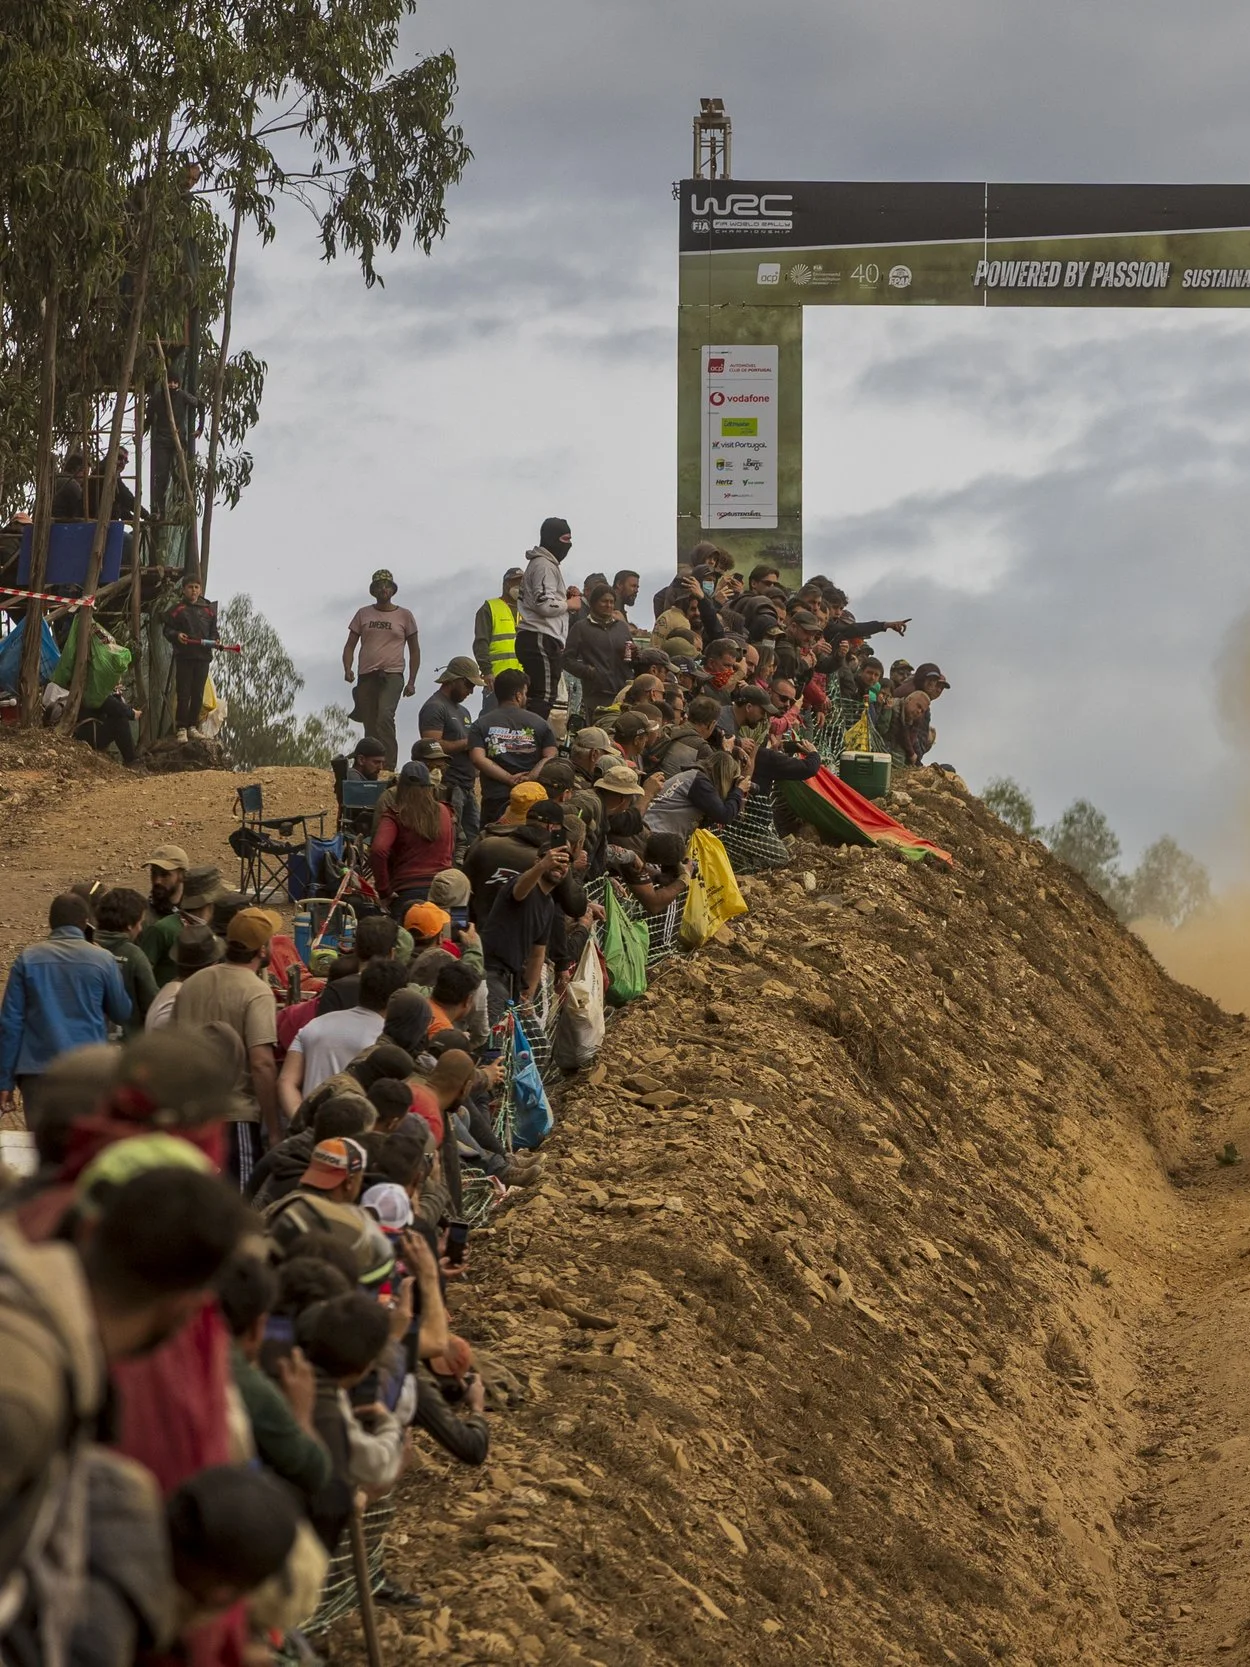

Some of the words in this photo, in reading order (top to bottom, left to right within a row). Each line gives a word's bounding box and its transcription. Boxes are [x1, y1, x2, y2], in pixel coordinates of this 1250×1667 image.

[691, 194, 793, 216] WRC
[692, 222, 710, 231] FIA
[850, 263, 880, 284] 40
[973, 260, 1062, 288] POWERED
[1063, 261, 1090, 288] BY
[1090, 261, 1170, 288] PASSION
[727, 394, 770, 403] vodafone
